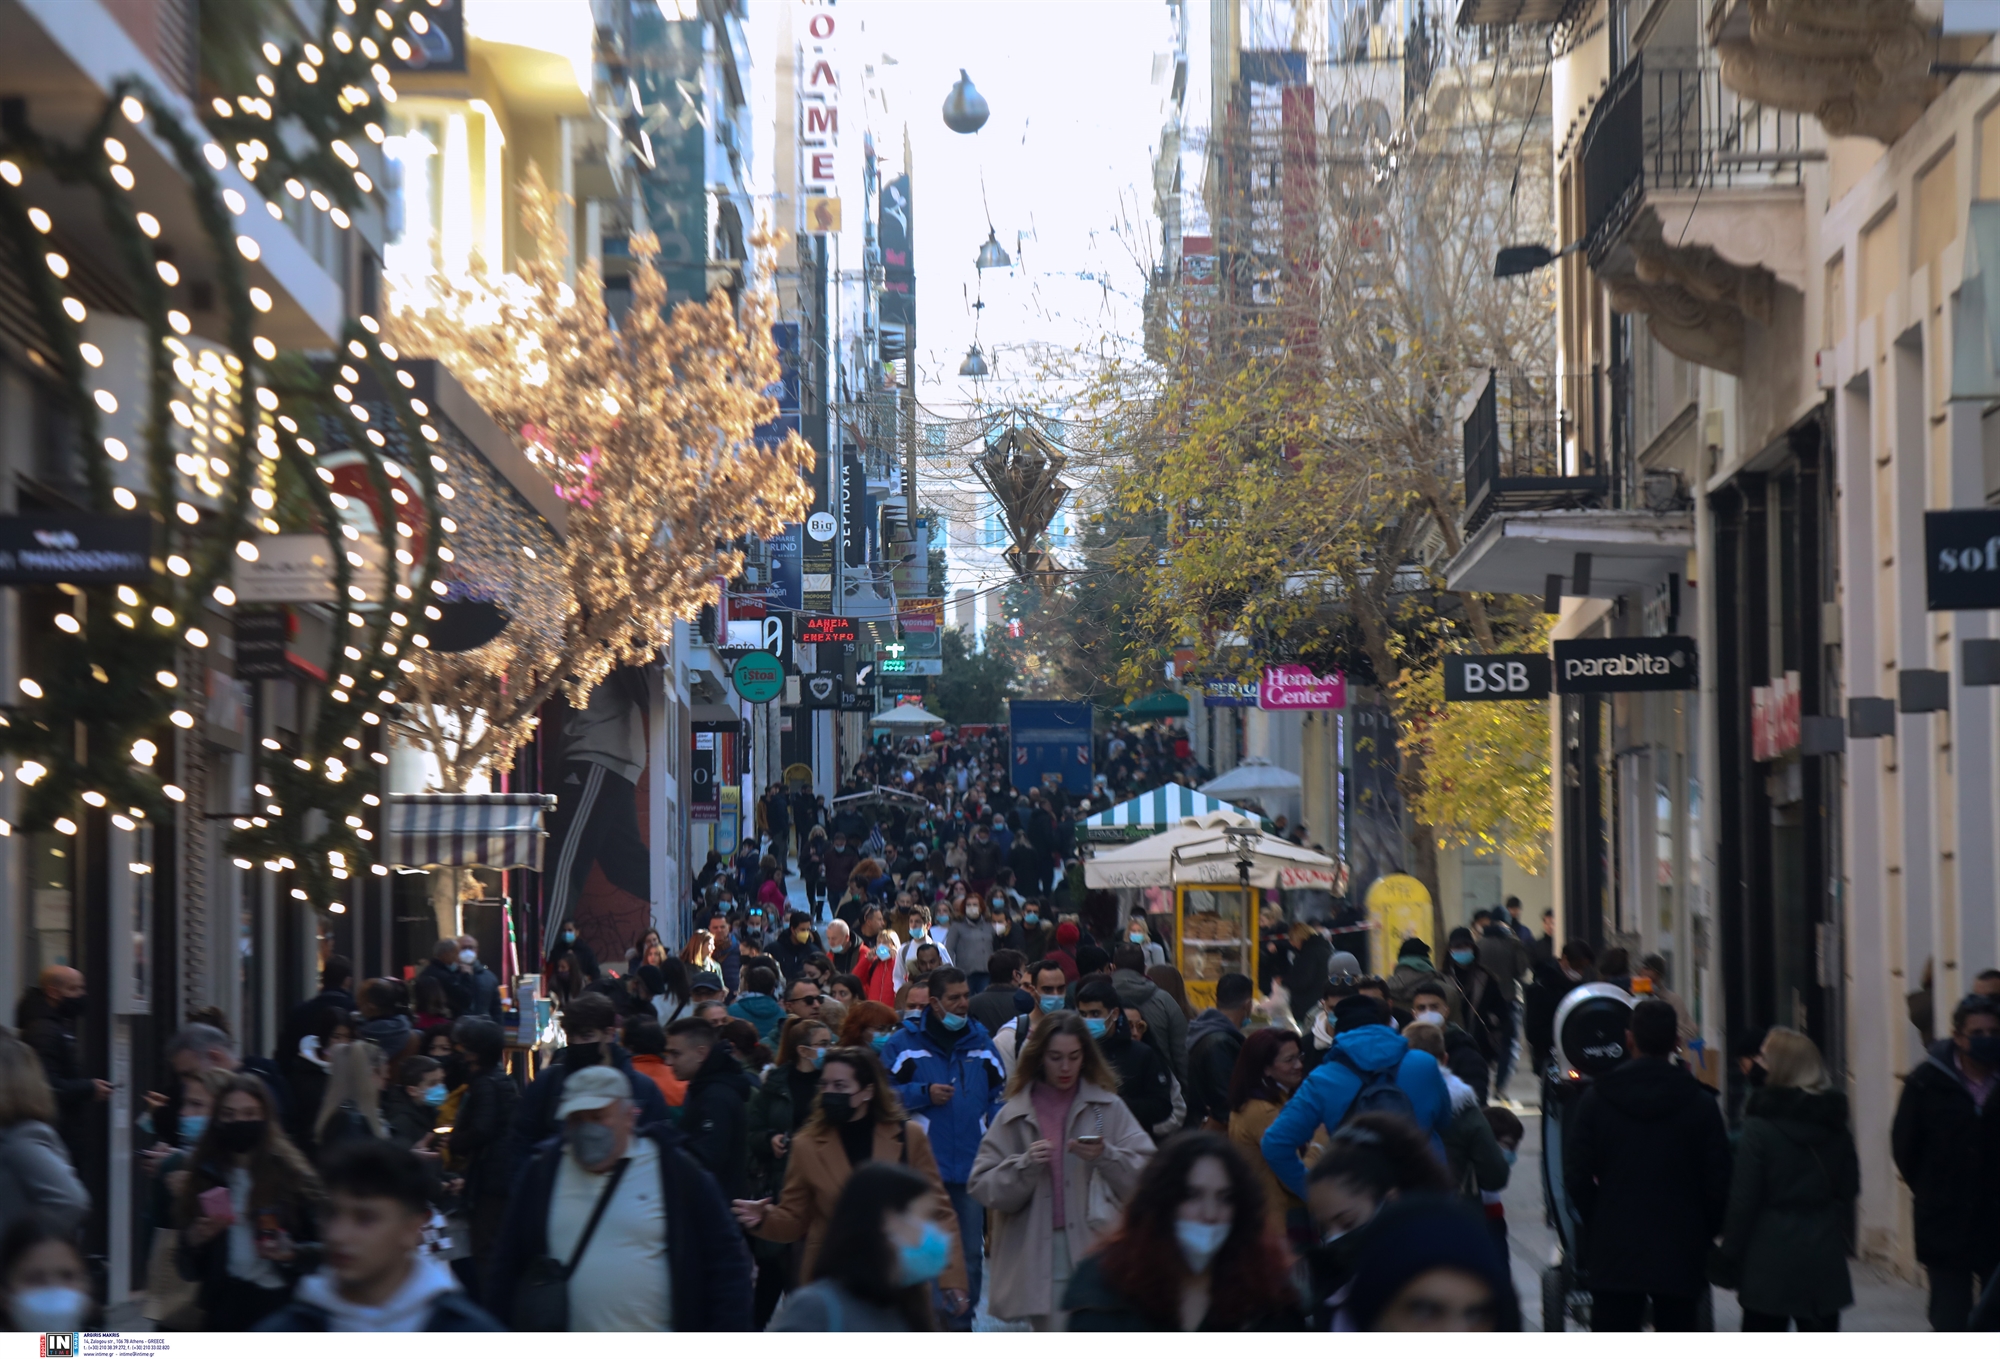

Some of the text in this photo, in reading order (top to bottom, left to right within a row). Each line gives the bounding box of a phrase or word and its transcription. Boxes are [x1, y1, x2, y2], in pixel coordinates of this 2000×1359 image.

[843, 465, 851, 547] SEPHORA
[811, 521, 832, 532] Big
[770, 542, 797, 552] RLIND
[808, 619, 849, 629] ΔΑΝΕΙΑ
[803, 633, 854, 642] ΕΝΕΧΥΡΟ
[1565, 654, 1670, 681] parabita
[743, 670, 775, 681] iStoa
[1464, 662, 1530, 693] BSB
[1266, 686, 1333, 704] Center
